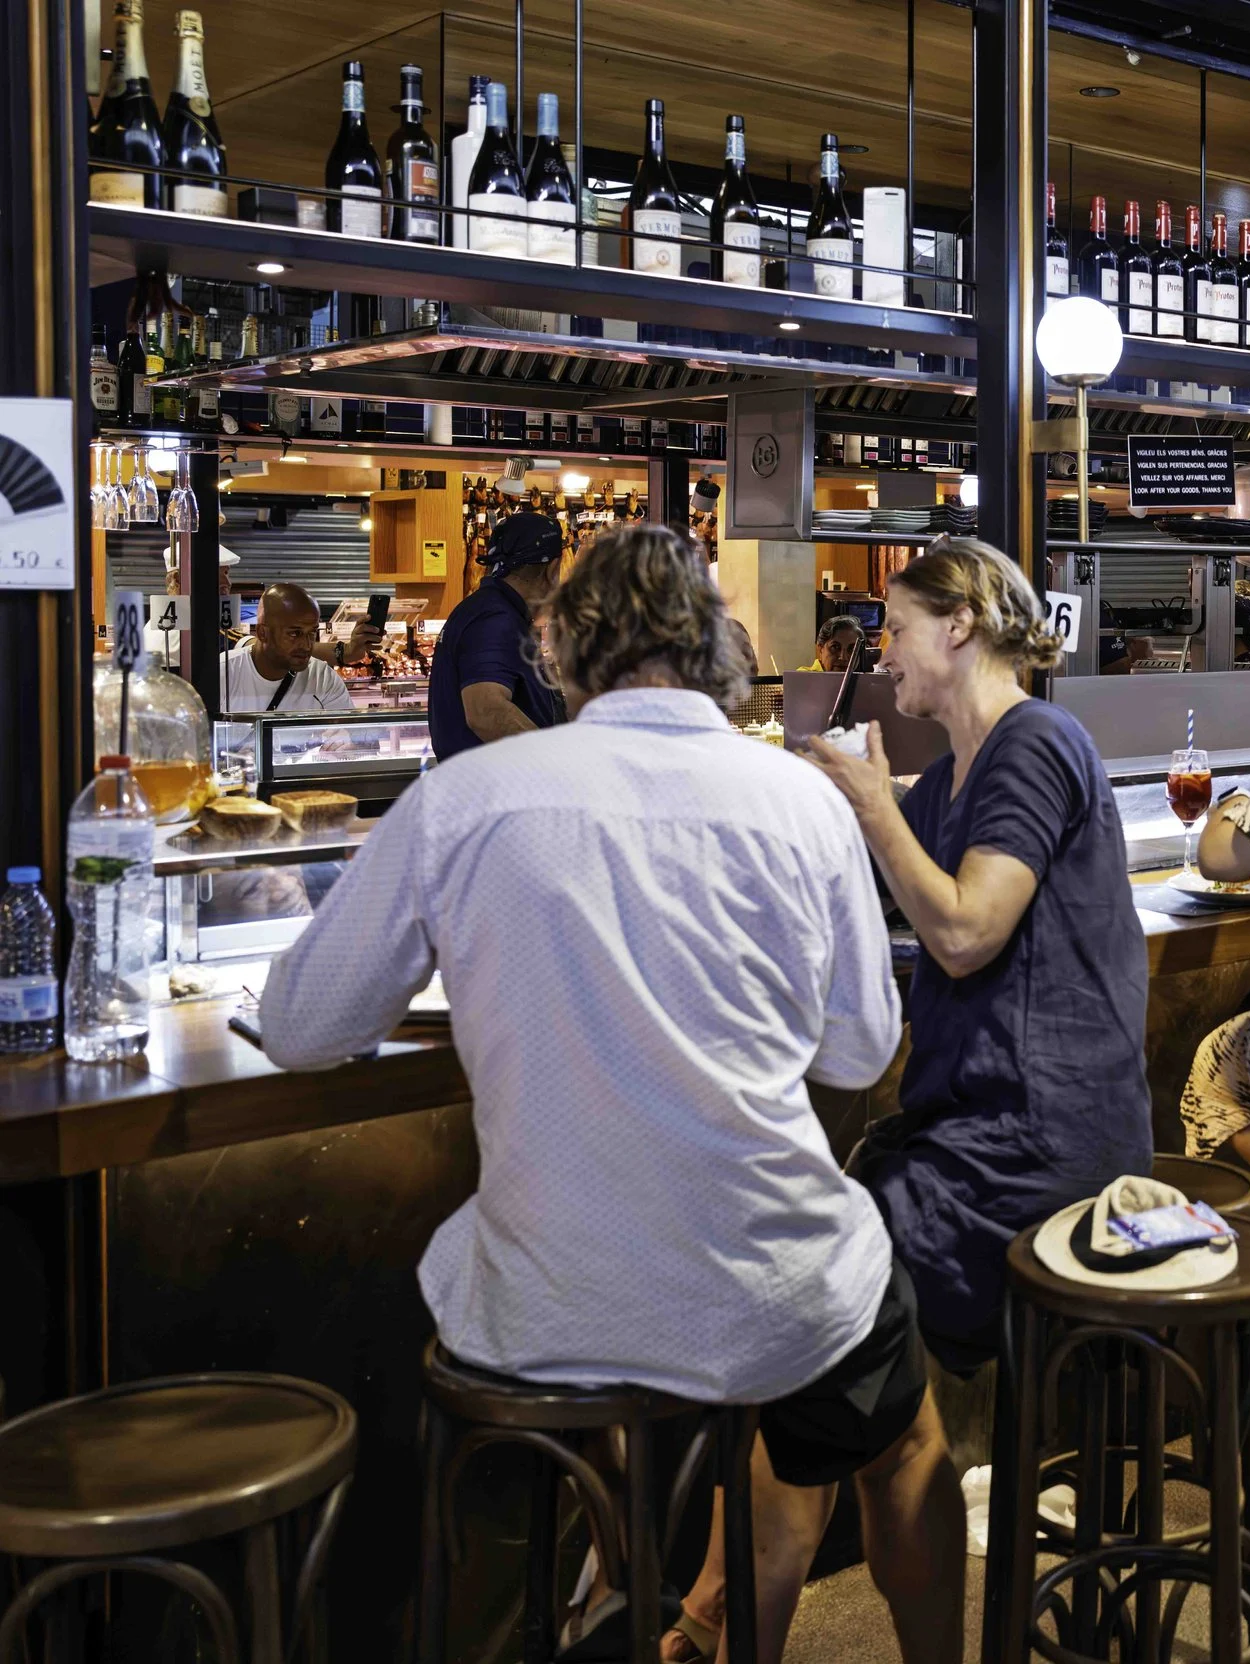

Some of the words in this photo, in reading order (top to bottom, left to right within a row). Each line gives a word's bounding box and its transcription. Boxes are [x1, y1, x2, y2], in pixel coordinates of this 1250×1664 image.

[1215, 290, 1235, 302] Protos
[1156, 449, 1166, 457] ELS
[1168, 449, 1190, 457] VOSTRES
